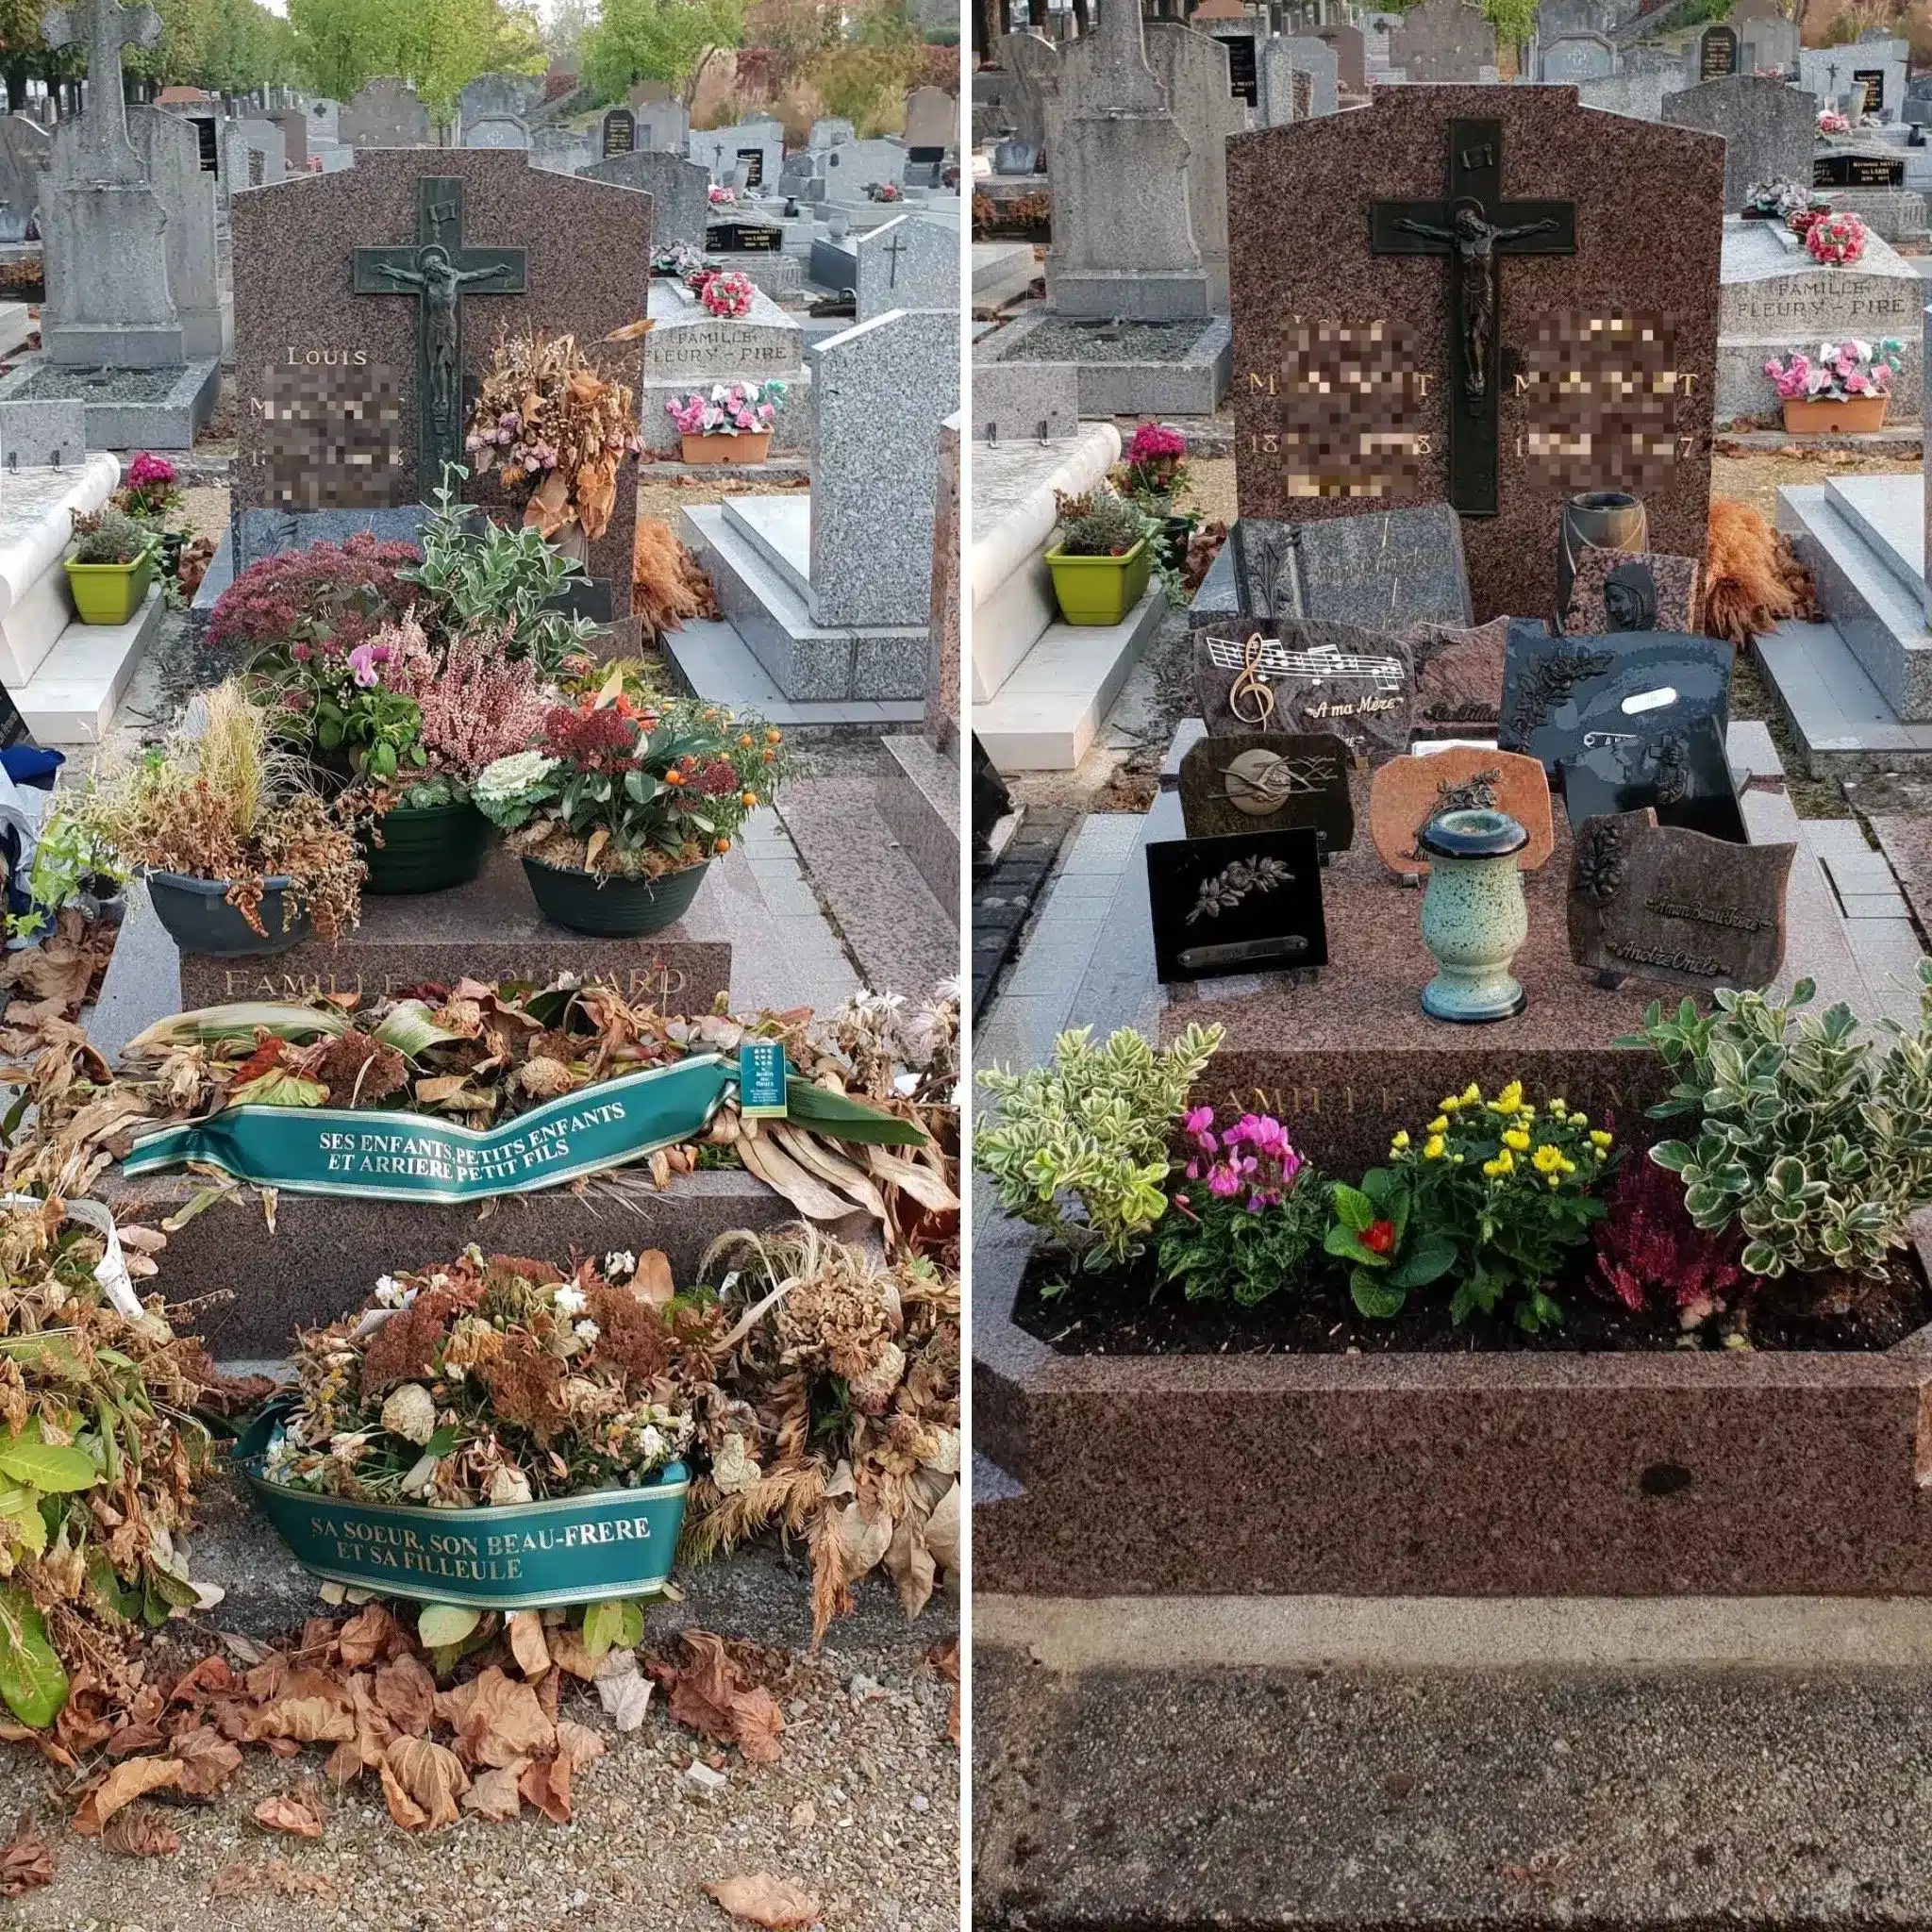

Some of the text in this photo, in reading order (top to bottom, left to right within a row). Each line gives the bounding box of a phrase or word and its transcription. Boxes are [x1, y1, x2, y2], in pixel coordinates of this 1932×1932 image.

[1851, 299, 1905, 315] PIRE
[741, 346, 787, 361] PIRE
[1331, 704, 1353, 717] ma
[319, 1132, 355, 1150] SES
[528, 1101, 626, 1148] ENFANTS
[327, 1139, 570, 1182] ET ARRIERE PETIT FILS
[310, 1517, 338, 1539] SA
[429, 1533, 478, 1557] SON
[487, 1517, 651, 1557] BEAU-FRERE
[337, 1541, 524, 1580] ET SA FILLEULE
